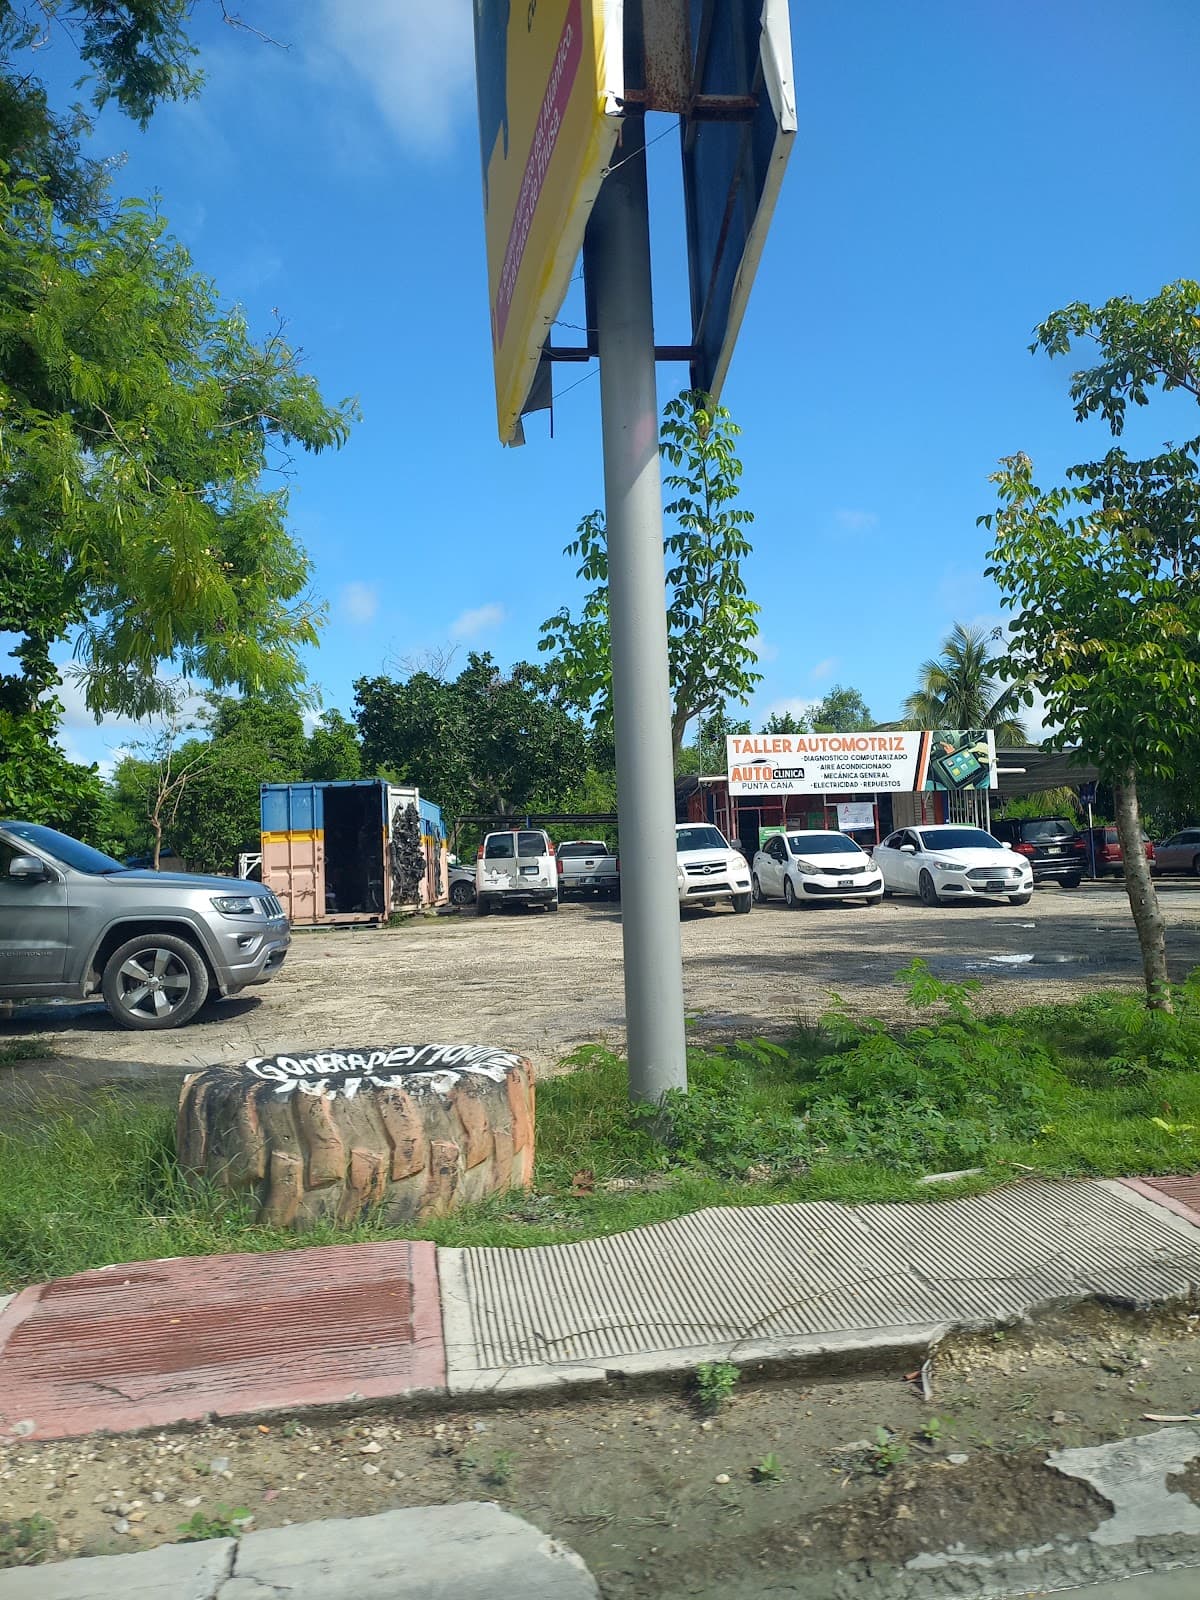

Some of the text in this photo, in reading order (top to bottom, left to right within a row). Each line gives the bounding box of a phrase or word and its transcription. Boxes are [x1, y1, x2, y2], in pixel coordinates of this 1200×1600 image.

[732, 737, 905, 754] TALLER AUTOMOTRIZ
[850, 753, 908, 761] COMPUTARIZADO
[731, 767, 804, 781] AUTO CLINICA
[742, 782, 769, 790] PUNTA
